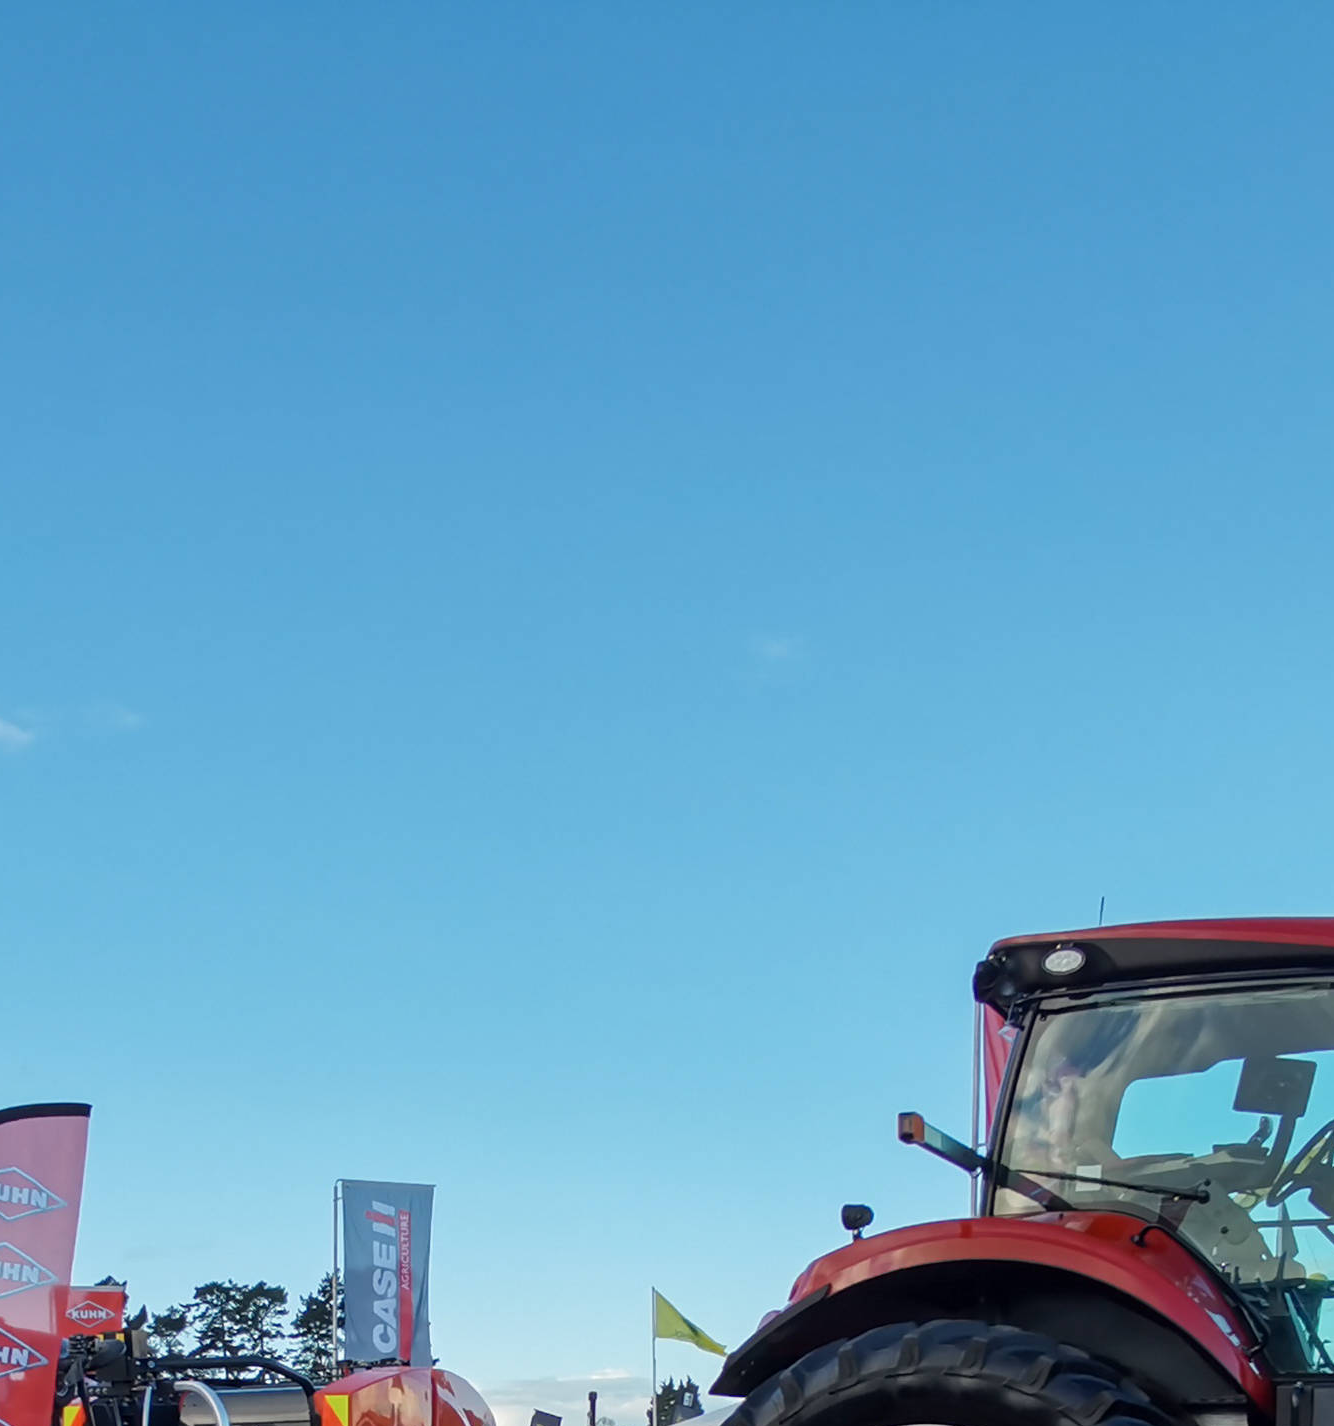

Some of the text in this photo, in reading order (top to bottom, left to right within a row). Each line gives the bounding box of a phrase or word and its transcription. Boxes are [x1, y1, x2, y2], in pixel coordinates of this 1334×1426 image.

[399, 1213, 411, 1291] AGRICULTURE
[71, 1308, 107, 1320] KUHN
[372, 1240, 398, 1354] CASE
